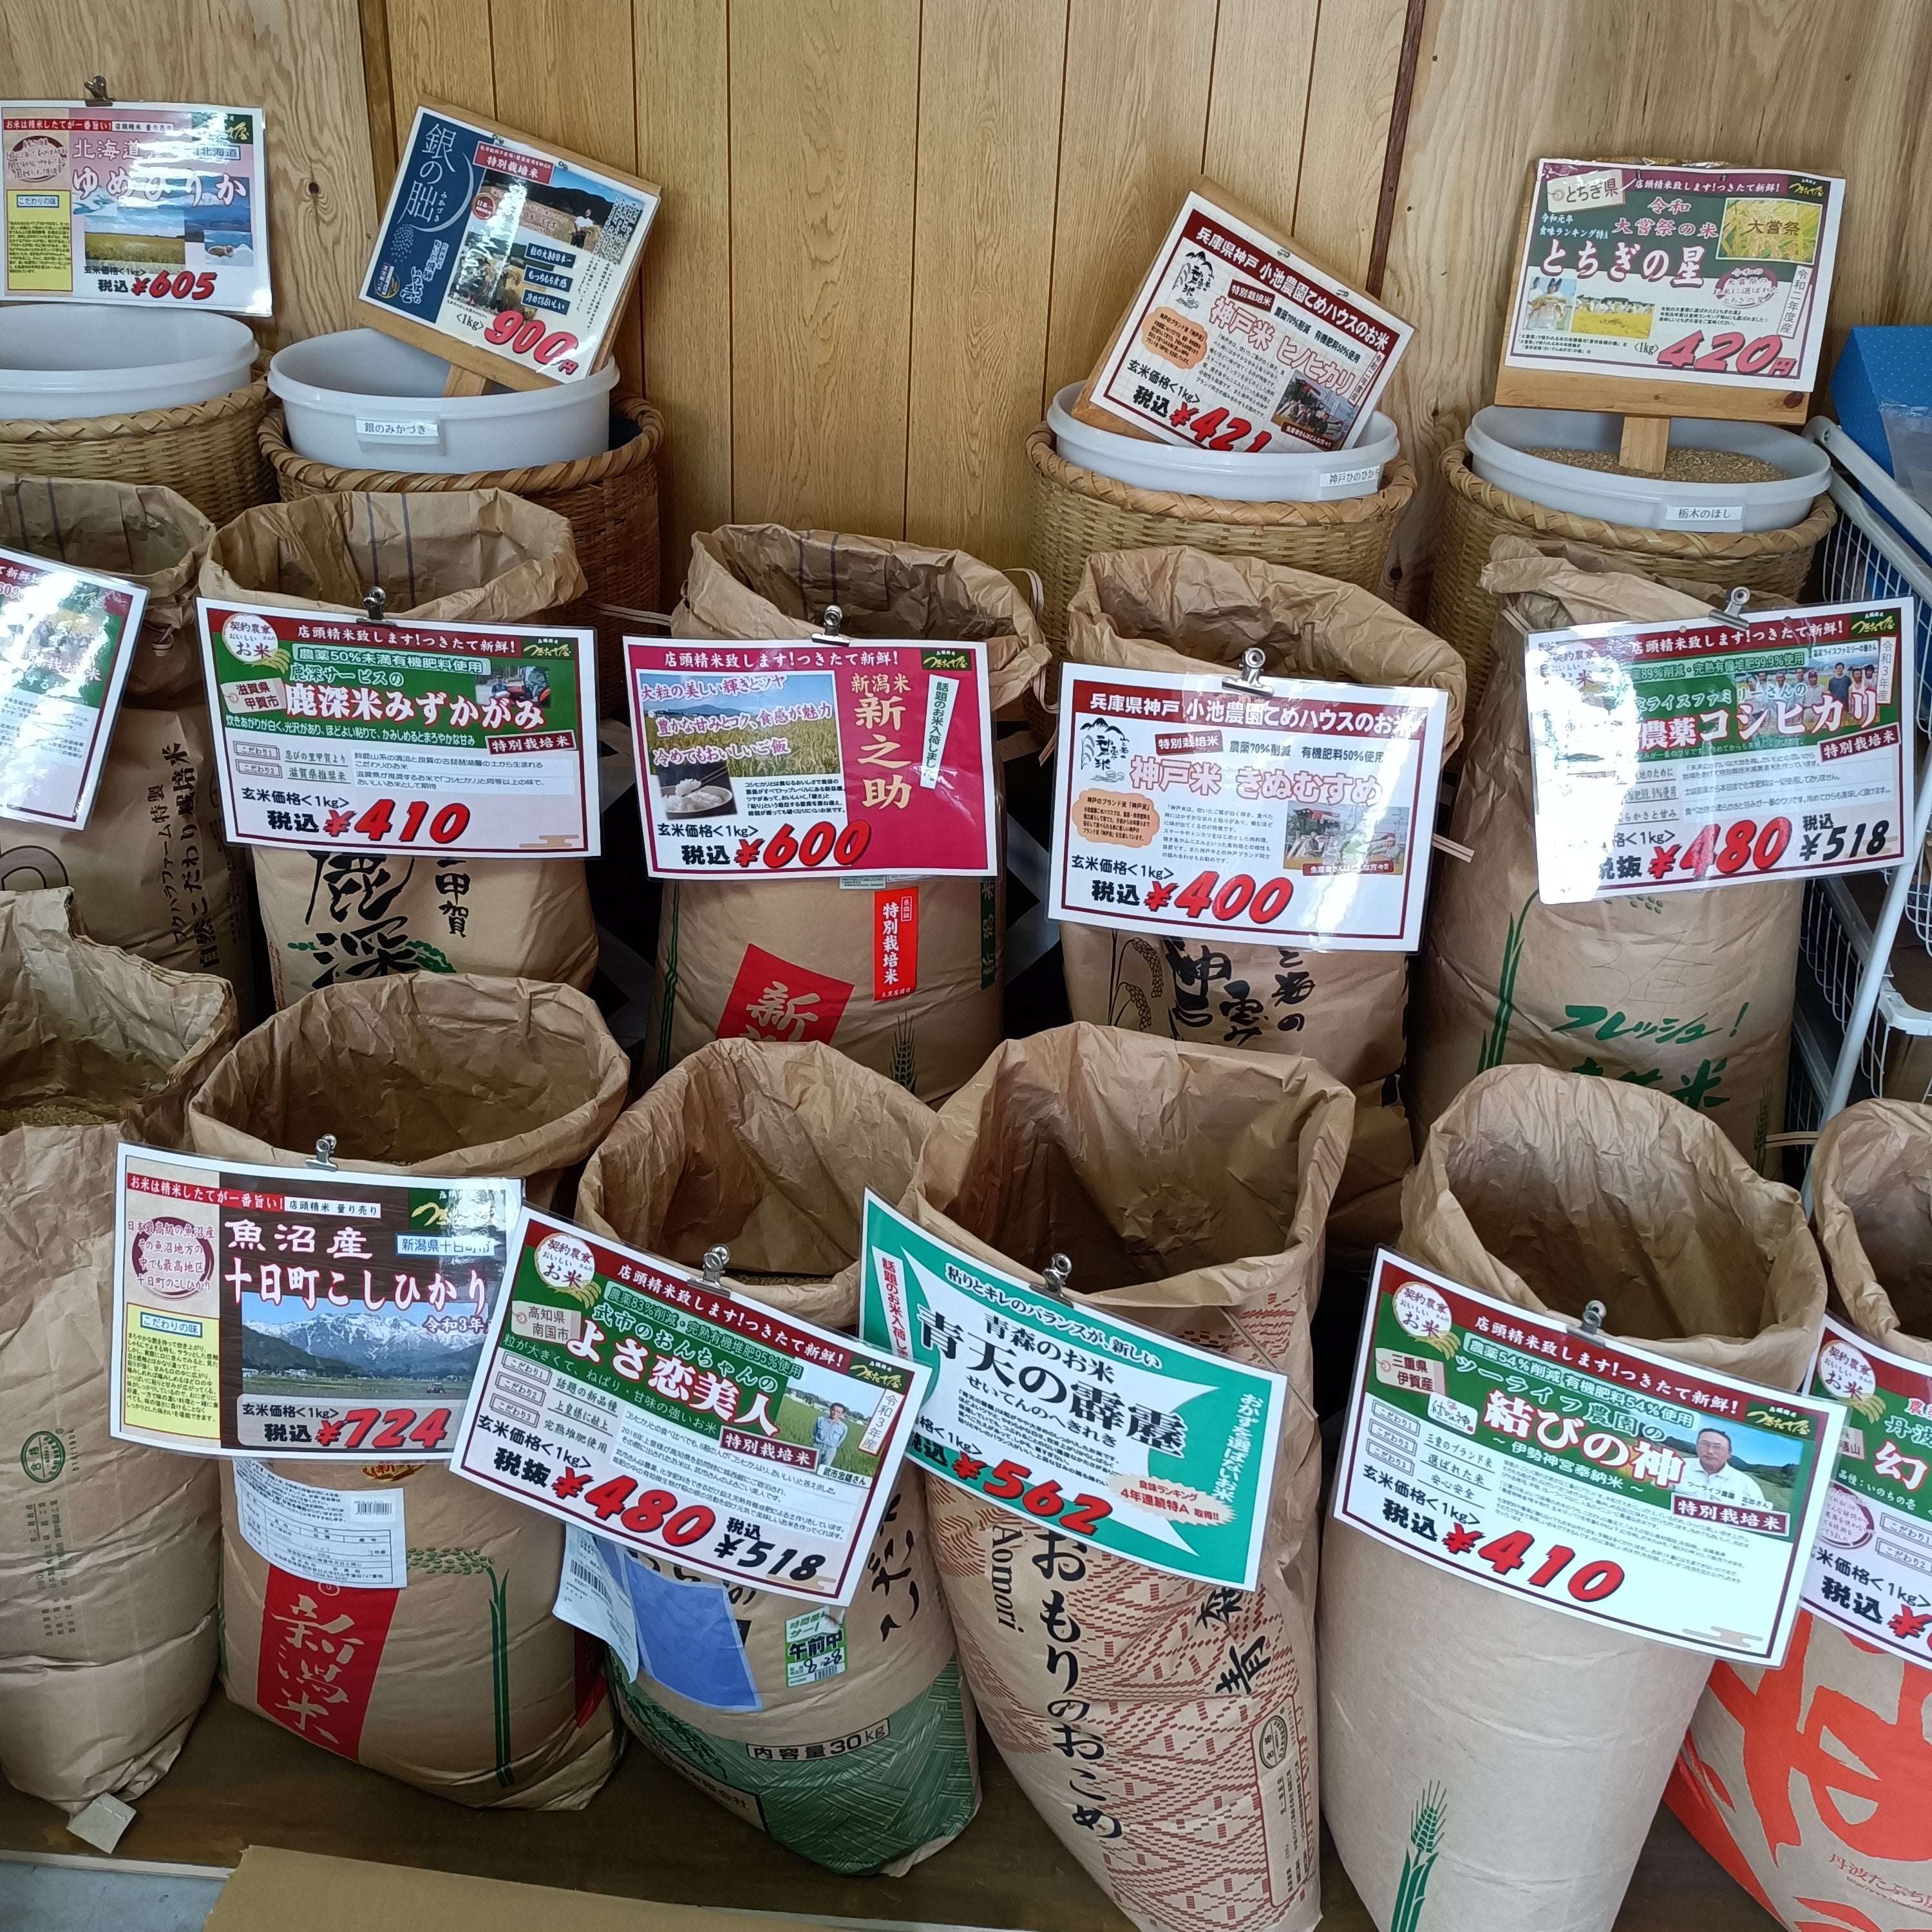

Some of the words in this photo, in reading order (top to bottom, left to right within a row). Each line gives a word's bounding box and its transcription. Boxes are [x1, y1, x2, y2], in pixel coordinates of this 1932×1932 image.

[487, 155, 538, 179] 特別栽培米
[1566, 178, 1619, 204] とちぎ県
[1648, 198, 1691, 215] 令和
[1541, 213, 1574, 224] 令和元年
[1611, 218, 1719, 239] 大嘗祭の米
[1748, 220, 1801, 234] 大嘗祭
[1196, 227, 1262, 268] 兵庫県神戸
[1540, 239, 1705, 289] とちぎの星
[98, 279, 129, 292] 税込
[131, 269, 218, 300] ¥605
[1230, 283, 1273, 307] 特別栽培米
[1779, 269, 1808, 334] 令和二年度産
[1209, 296, 1274, 353] 神戸米
[1276, 336, 1358, 395] ヒノヒカリ
[1133, 384, 1170, 418] 税込
[365, 421, 426, 435] 銀のみかづき
[1678, 507, 1731, 519] 栃木のほし
[230, 621, 272, 634] 契約農家
[298, 625, 516, 654] 店頭精米致します!つきたて新鮮!
[236, 641, 272, 659] お米
[299, 647, 483, 674] 農薬50%未満有機肥料使用
[665, 650, 898, 668] 店頭精米致します!つきたて新鮮!
[289, 664, 404, 687] 鹿深サービスの
[851, 672, 912, 694] 新潟米
[1879, 640, 1893, 702] 令和3年産
[236, 681, 271, 695] 滋賀県
[245, 694, 279, 708] 甲賀市
[641, 675, 786, 701] 大粒の美しい輝きとツヤ
[285, 683, 545, 730] 鹿深米みずかがみ
[656, 702, 832, 735] 豊かな甘みとコク、食感が魅力
[1090, 692, 1180, 717] 兵庫県神戸
[492, 735, 570, 753] 特別栽培米
[654, 738, 790, 766] 冷めてもおいしいご飯
[853, 694, 912, 810] 新之助
[1159, 734, 1220, 750] 特別栽培米
[1823, 730, 1896, 757] 特別栽培米
[355, 761, 408, 770] こだわりのお米
[1130, 755, 1222, 796] 神戸米
[1236, 767, 1383, 806] きぬむすめ
[241, 787, 350, 809] 玄米価格<1kg>
[267, 810, 319, 833] 税込
[323, 798, 471, 844] ¥410
[657, 823, 759, 838] 玄米価格<1kg>
[1802, 813, 1834, 831] 税込
[681, 845, 730, 866] 税込
[734, 820, 872, 869] ¥600
[1647, 816, 1792, 880] ¥480
[1799, 820, 1889, 862] ¥518
[1072, 855, 1175, 880] 玄米価格<1kg>
[1091, 880, 1140, 906] 税込
[1144, 871, 1294, 925] ¥400
[882, 902, 900, 985] 特別栽培米
[130, 1175, 283, 1211] お米は精米したてが一番旨い!
[289, 1200, 330, 1213] 店頭精米
[337, 1203, 378, 1217] 量り売り
[128, 1220, 215, 1239] 日本最高級の魚沼産
[224, 1218, 374, 1260] 魚沼産
[137, 1239, 203, 1255] その魚沼地方の
[542, 1251, 573, 1267] おいしい
[547, 1238, 594, 1265] 契約農家
[138, 1256, 204, 1273] 中でも最高地区
[542, 1265, 583, 1289] お米
[137, 1275, 211, 1293] 十日町のこしひかり
[224, 1256, 487, 1318] 十日町こしひかり
[528, 1305, 565, 1323] 高知県
[617, 1264, 844, 1368] 店頭精米致します!つきたて新鮮!
[1399, 1299, 1429, 1316] おいしい
[1403, 1287, 1449, 1314] 契約農家
[142, 1313, 200, 1335] こだわりの味
[945, 1262, 1162, 1371] 粘りとキレのバランスが、新しい
[1401, 1311, 1441, 1338] お米
[533, 1325, 569, 1342] 南国市
[591, 1303, 779, 1393] 武市のおんちゃんの
[609, 1286, 804, 1379] 農薬83%削減・完熟有機堆肥95%使用
[984, 1312, 1116, 1385] 青森のお米
[1391, 1354, 1428, 1373] 三重県
[1829, 1345, 1873, 1377] 契約農家
[567, 1319, 781, 1439] よさ恋美人
[917, 1303, 1188, 1459] 青天の霹靂
[1397, 1370, 1434, 1392] 伊賀産
[1474, 1316, 1739, 1415] 店頭精米致します!つきたて新鮮!
[556, 1377, 618, 1413] 話題の新品種
[1454, 1353, 1667, 1442] ツーライフ農園の
[1469, 1340, 1562, 1384] 農薬54%削減
[1564, 1374, 1694, 1428] 有機肥料54%使用
[1825, 1371, 1864, 1401] お米
[242, 1403, 339, 1419] 玄米価格<1kg>
[553, 1400, 609, 1432] 上皇様に献上
[860, 1392, 898, 1452] 令和3年産
[965, 1374, 1118, 1449] せいてんのへきれき
[264, 1423, 312, 1443] 税込
[315, 1407, 452, 1449] ¥724
[477, 1415, 592, 1470] 玄米価格<1kg>
[542, 1419, 609, 1454] 完熟堆肥使用
[1483, 1387, 1686, 1490] 結びの神
[724, 1432, 812, 1466] 特別栽培米
[1213, 1392, 1264, 1505] おかずを選ばないお米
[822, 1467, 867, 1486] 武市忠雄さん
[1427, 1452, 1485, 1487] 選ばれた米
[1511, 1440, 1624, 1490] 伊勢神宮奉納米
[1874, 1440, 1929, 1493] 幻
[493, 1446, 551, 1488] 税抜
[551, 1467, 716, 1546] ¥480
[951, 1450, 1113, 1536] ¥562
[1120, 1488, 1189, 1515] 4年連続特A
[1139, 1480, 1198, 1502] 食味ランキング
[1363, 1464, 1481, 1525] 玄米価格<1kg>
[1430, 1473, 1475, 1501] 安心安全
[726, 1517, 761, 1539] 税込
[1677, 1499, 1781, 1531] 特別栽培米
[1890, 1522, 1930, 1544] こだわり1
[712, 1534, 826, 1582] ¥518
[1382, 1497, 1438, 1543] 税込
[1441, 1522, 1626, 1604] ¥410
[1886, 1546, 1926, 1569] こだわり2
[992, 1525, 1026, 1634] Aomori
[1821, 1575, 1884, 1625] 税込
[788, 1629, 844, 1662] 午前中
[753, 1724, 887, 1761] 内容量30kg
